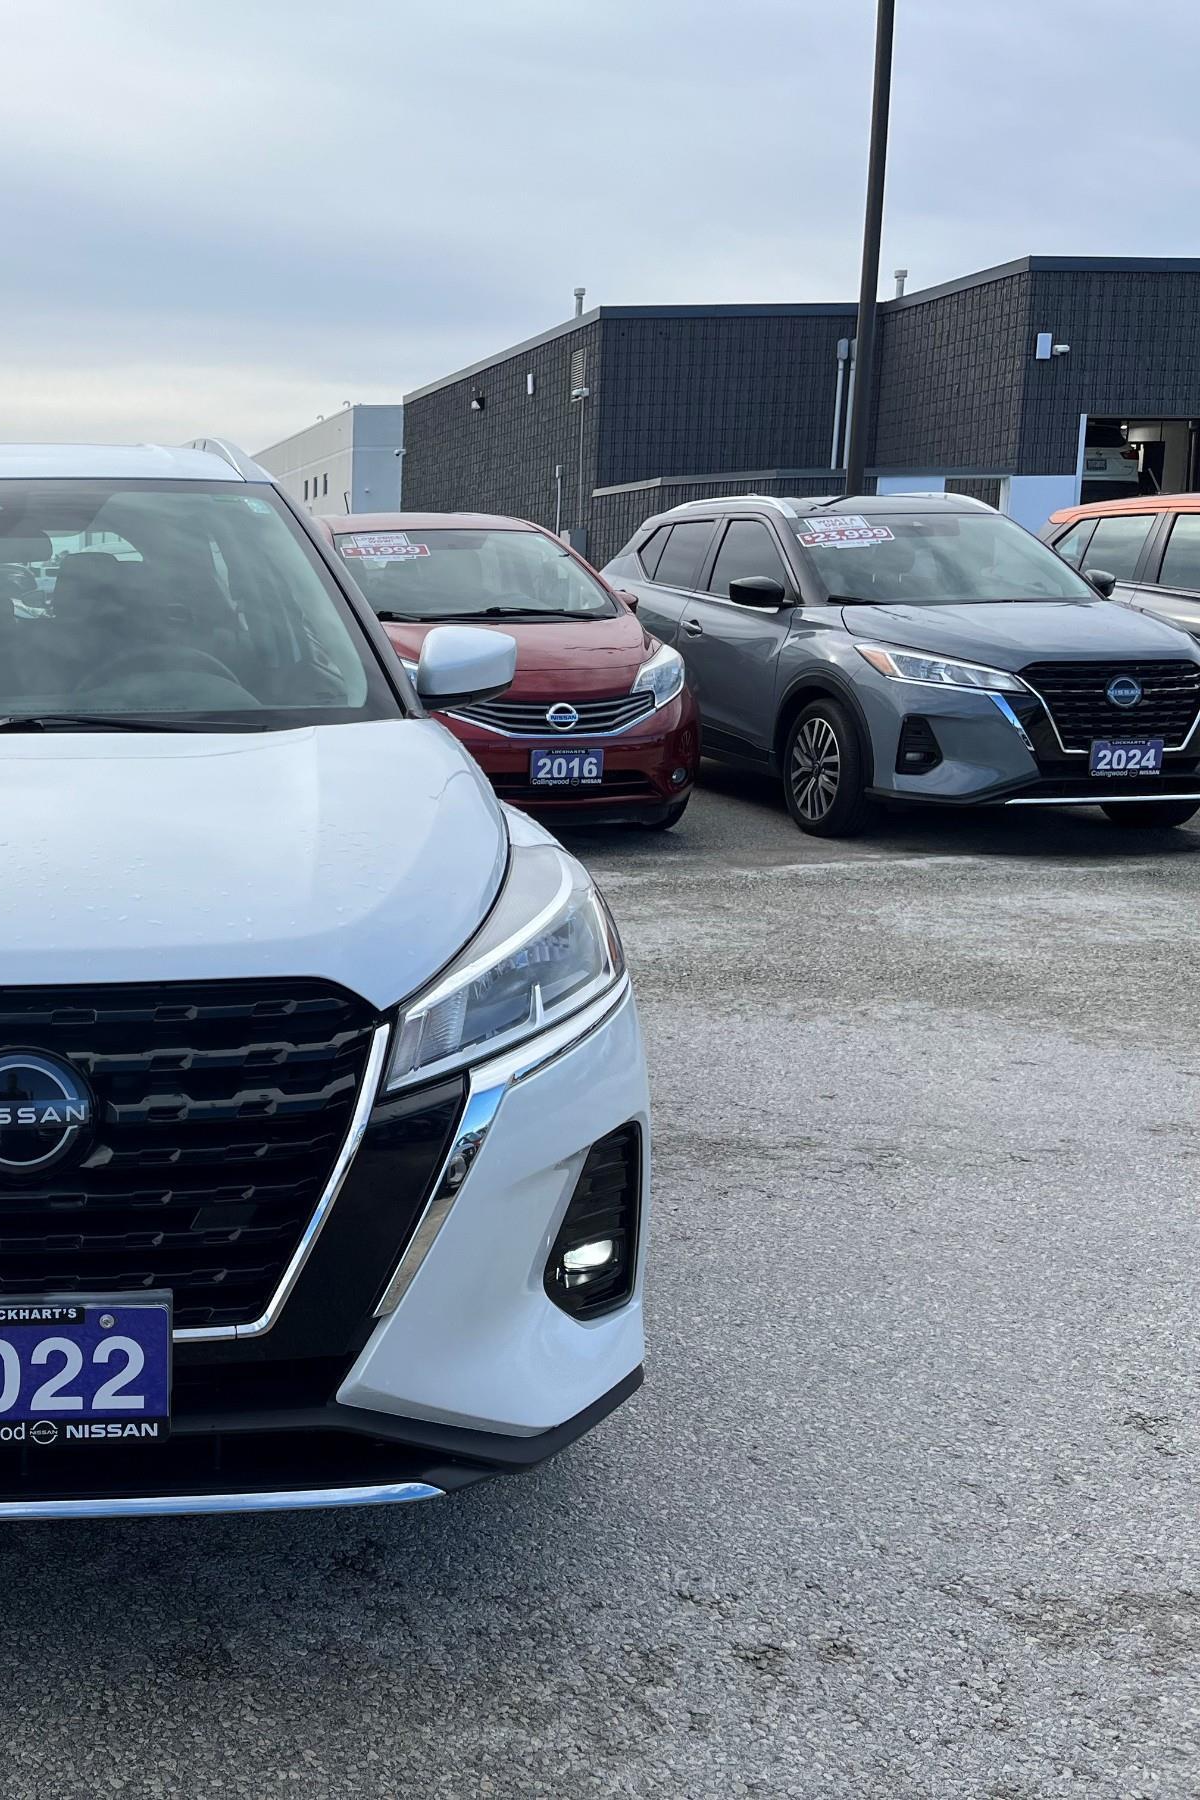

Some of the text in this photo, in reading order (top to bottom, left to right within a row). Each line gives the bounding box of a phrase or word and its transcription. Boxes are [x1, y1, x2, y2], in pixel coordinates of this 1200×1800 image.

[803, 528, 888, 543] $23,999
[346, 546, 420, 555] $11,999
[1096, 748, 1156, 769] 2024
[537, 757, 598, 778] 2016
[532, 778, 570, 786] Collingwood
[66, 1423, 158, 1438] NISSAN
